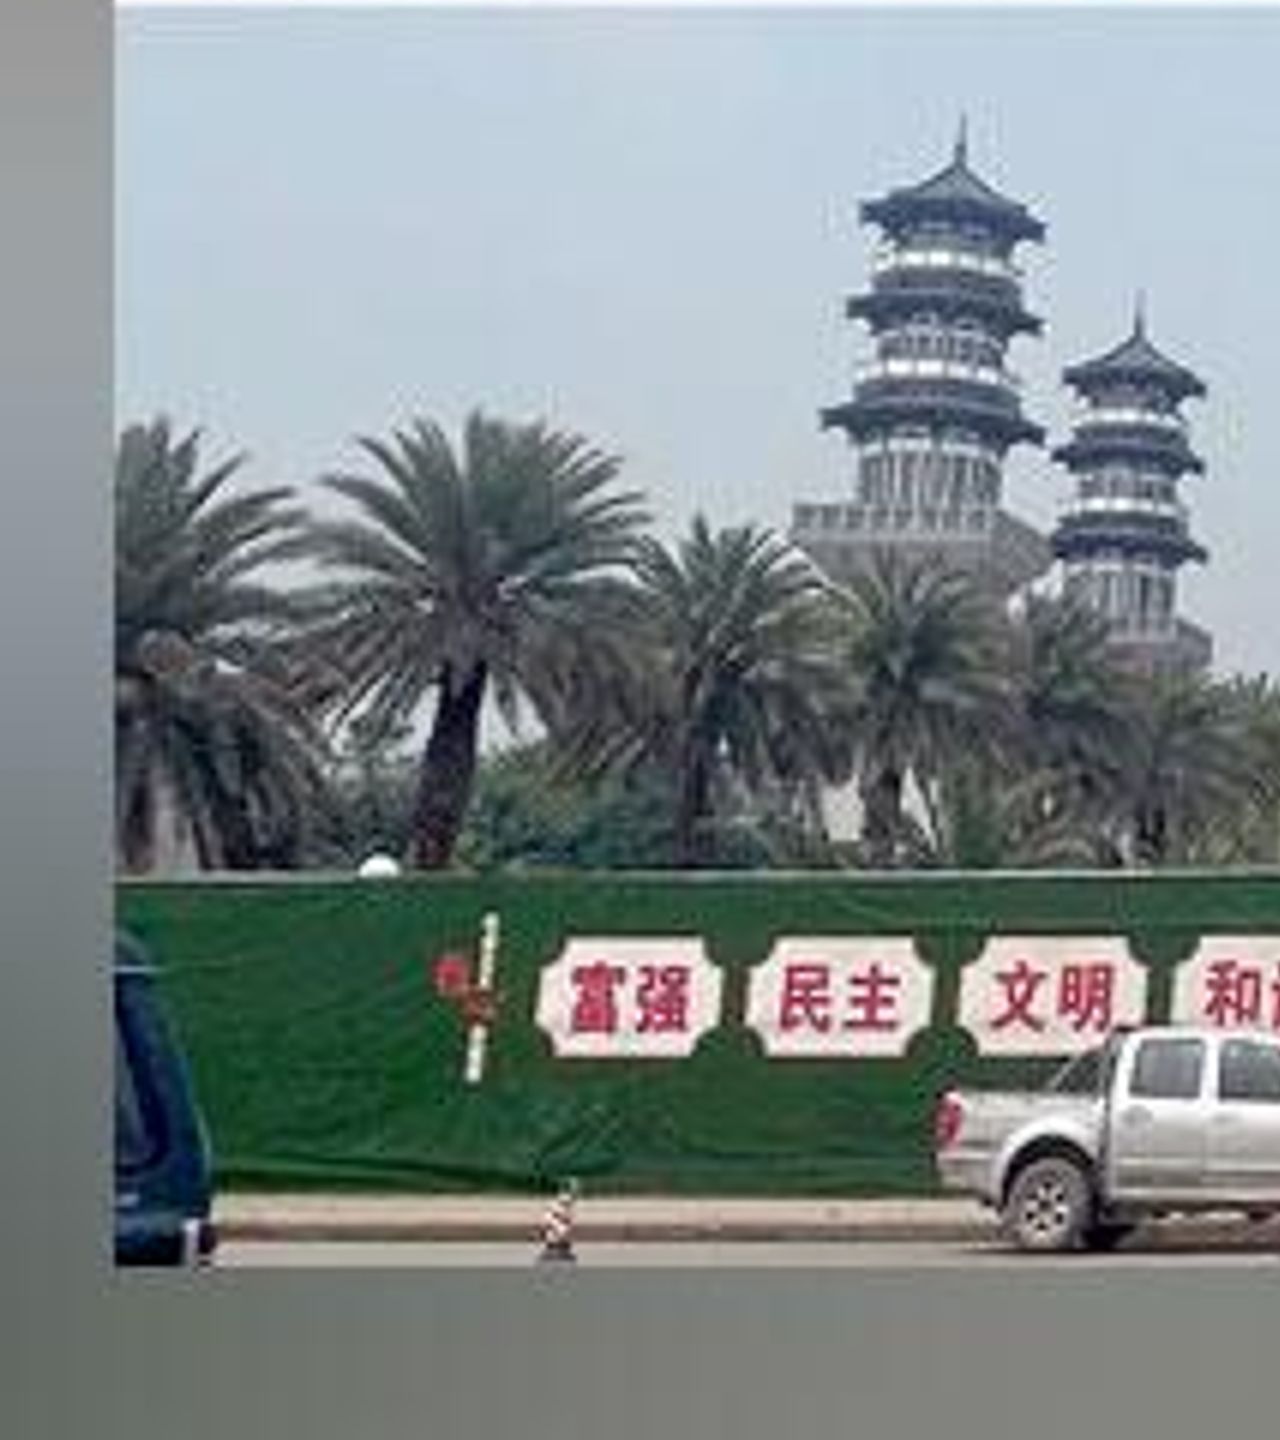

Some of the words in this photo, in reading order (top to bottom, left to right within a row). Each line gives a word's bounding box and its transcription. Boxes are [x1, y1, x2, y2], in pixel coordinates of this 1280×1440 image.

[569, 965, 693, 1034] 富强
[778, 964, 903, 1033] 民主
[990, 961, 1119, 1032] 文明
